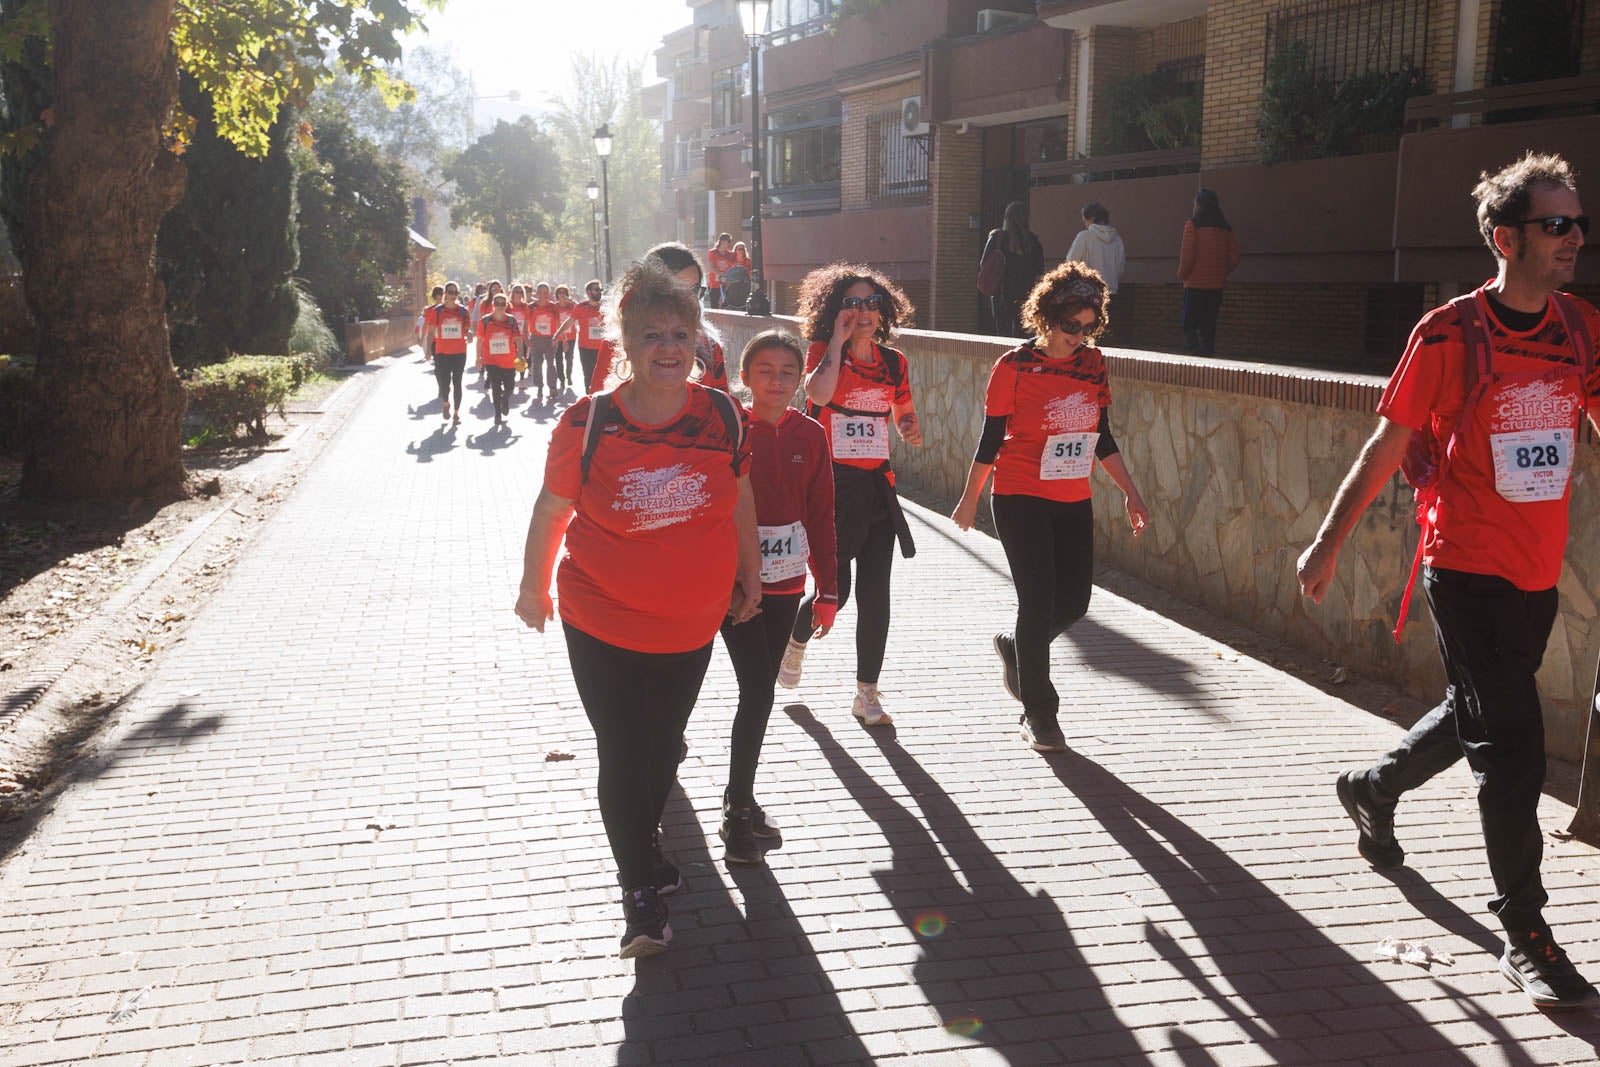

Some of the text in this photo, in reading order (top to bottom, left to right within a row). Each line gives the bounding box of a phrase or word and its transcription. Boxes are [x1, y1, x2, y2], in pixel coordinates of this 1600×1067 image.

[1048, 404, 1097, 420] carrera
[1499, 399, 1572, 417] carrera
[846, 423, 875, 437] 513
[1501, 416, 1571, 430] cruzroja.es
[1055, 442, 1082, 457] 515
[1516, 445, 1560, 468] 828
[1532, 470, 1554, 479] VICTOR
[622, 479, 700, 498] carrera
[623, 494, 703, 511] cruzroja.es
[760, 537, 792, 557] 441
